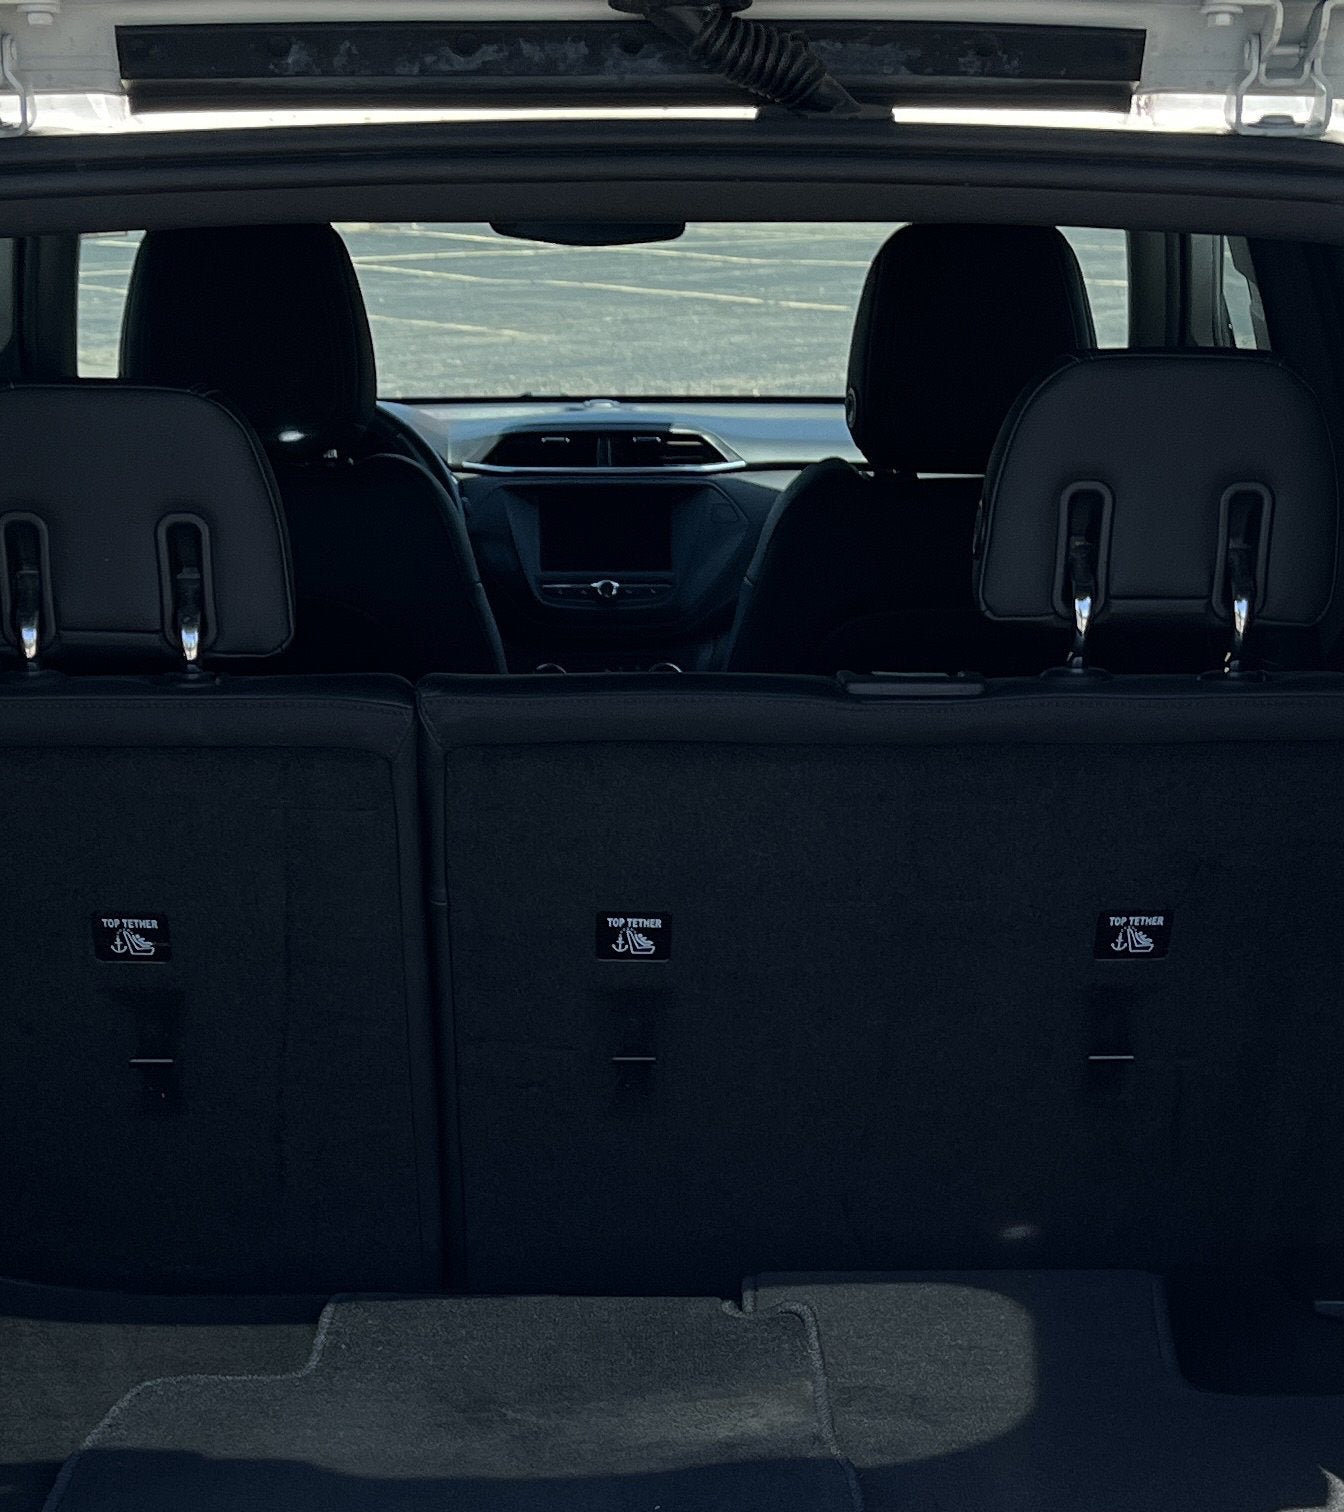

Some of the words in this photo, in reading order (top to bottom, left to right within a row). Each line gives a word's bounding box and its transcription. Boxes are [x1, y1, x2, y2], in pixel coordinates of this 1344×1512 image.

[101, 918, 120, 928] TOP
[121, 918, 158, 929] TETHER
[606, 917, 625, 928] TOP
[626, 918, 662, 928] TETHER
[1109, 916, 1127, 927] TOP
[1129, 916, 1164, 926] TETHER
